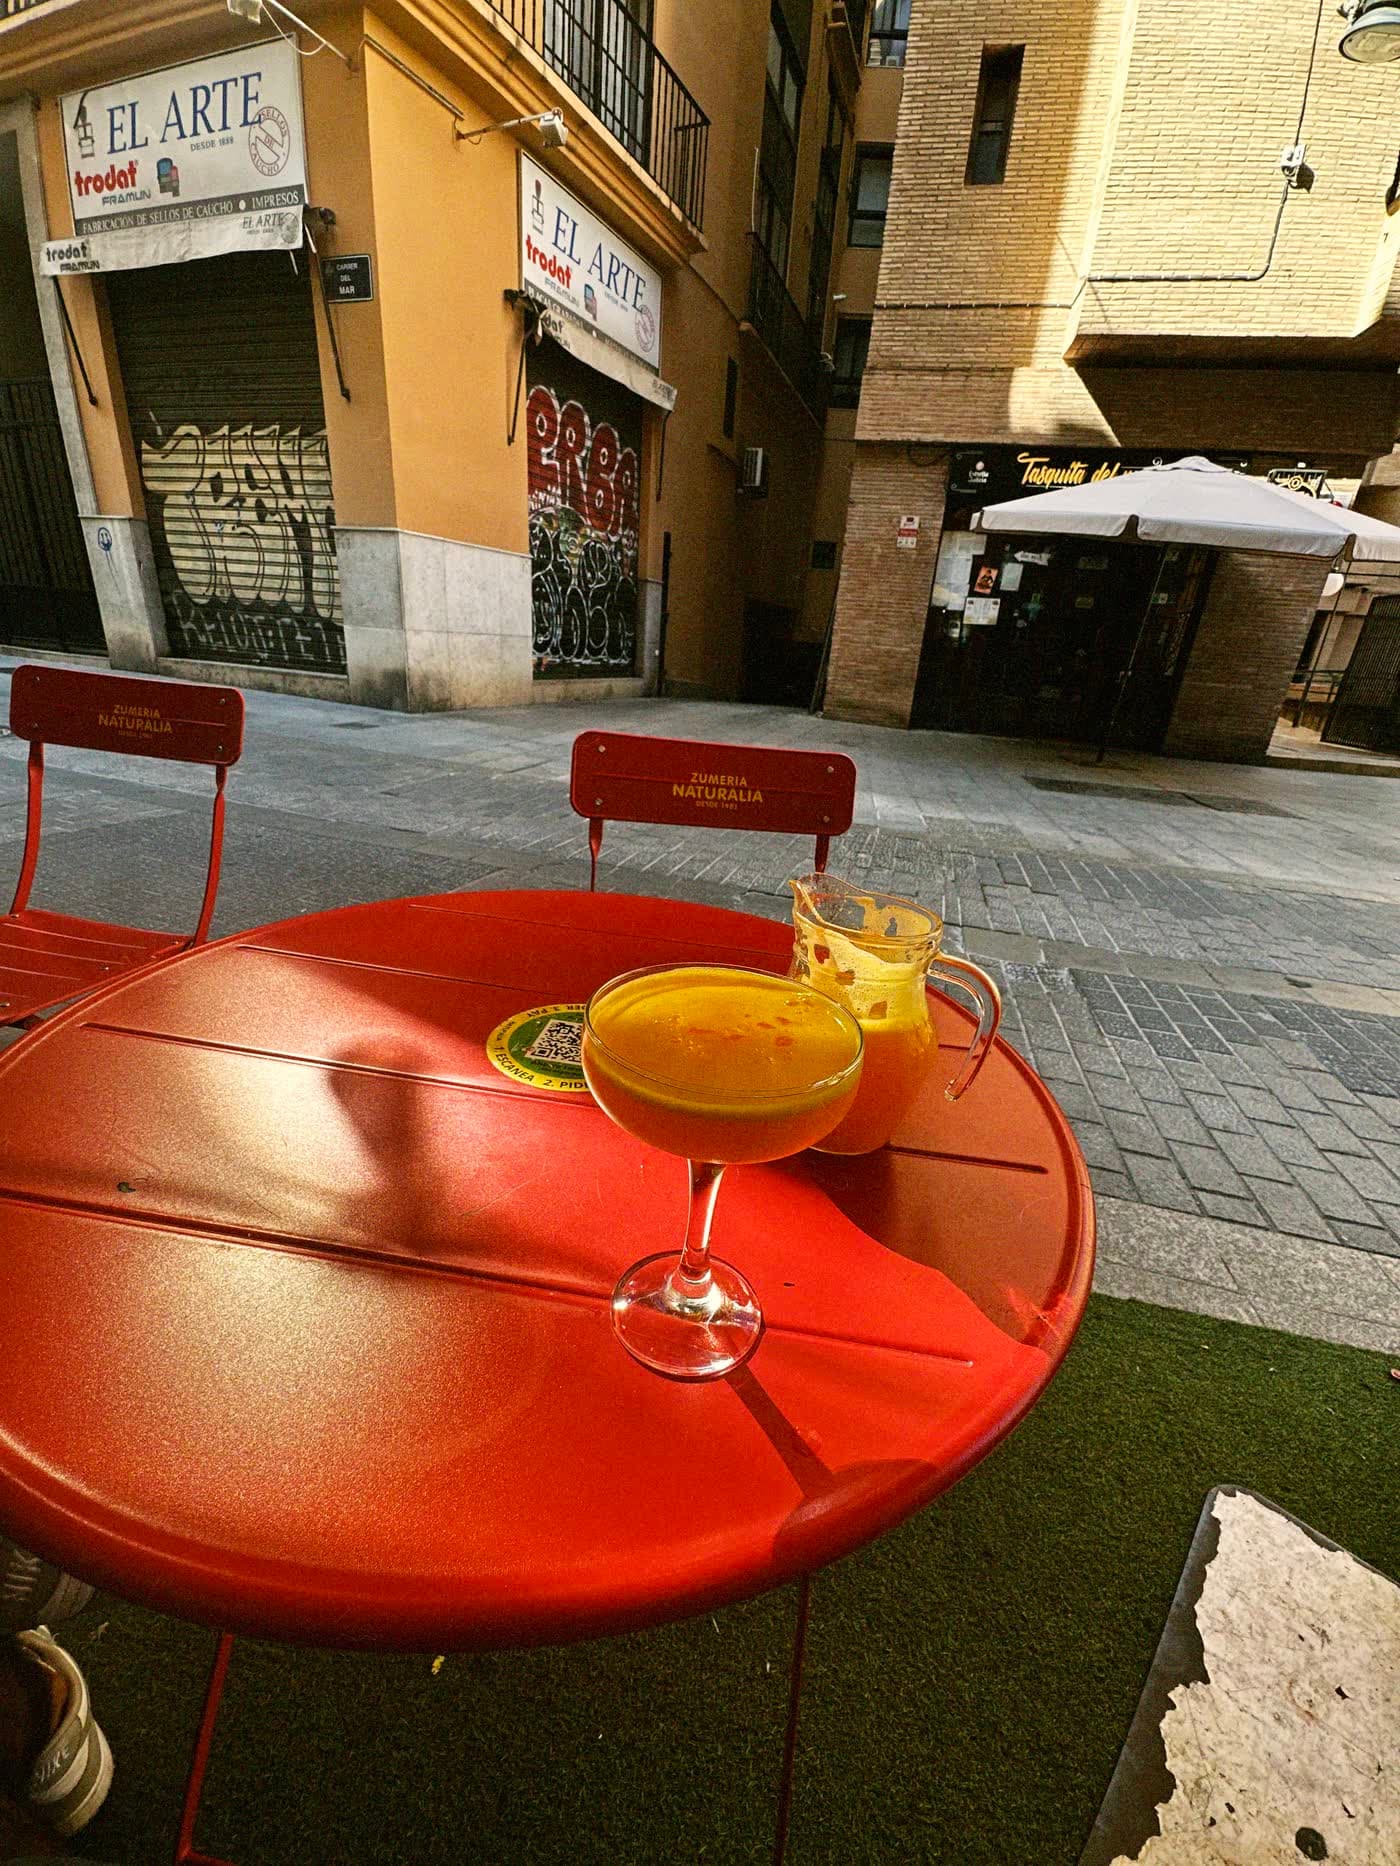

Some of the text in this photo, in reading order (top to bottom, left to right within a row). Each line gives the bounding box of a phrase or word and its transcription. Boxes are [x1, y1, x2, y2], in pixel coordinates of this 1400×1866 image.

[107, 72, 262, 154] EL ARTE
[190, 140, 216, 152] DESDE
[250, 143, 280, 175] CAUCHO
[74, 160, 137, 197] trodat
[102, 189, 151, 207] FRAMUN
[251, 193, 299, 210] IMPRESOS
[137, 214, 148, 226] DE
[149, 208, 180, 223] SELLOS
[182, 206, 194, 218] DE
[197, 201, 233, 217] CAUCHO
[46, 242, 87, 262] trodat
[526, 232, 572, 289] trodat
[552, 206, 646, 313] EL ARTE
[340, 274, 351, 282] DEL
[339, 285, 355, 295] MAR
[1017, 452, 1121, 490] Tasquita del
[113, 704, 160, 719] ZUMERIA
[98, 713, 173, 734] NATURALIA
[691, 772, 748, 787] ZUMERIA
[672, 783, 763, 803] NATURALIA
[495, 1053, 535, 1082] ESCANEA
[543, 1079, 555, 1088] 2.
